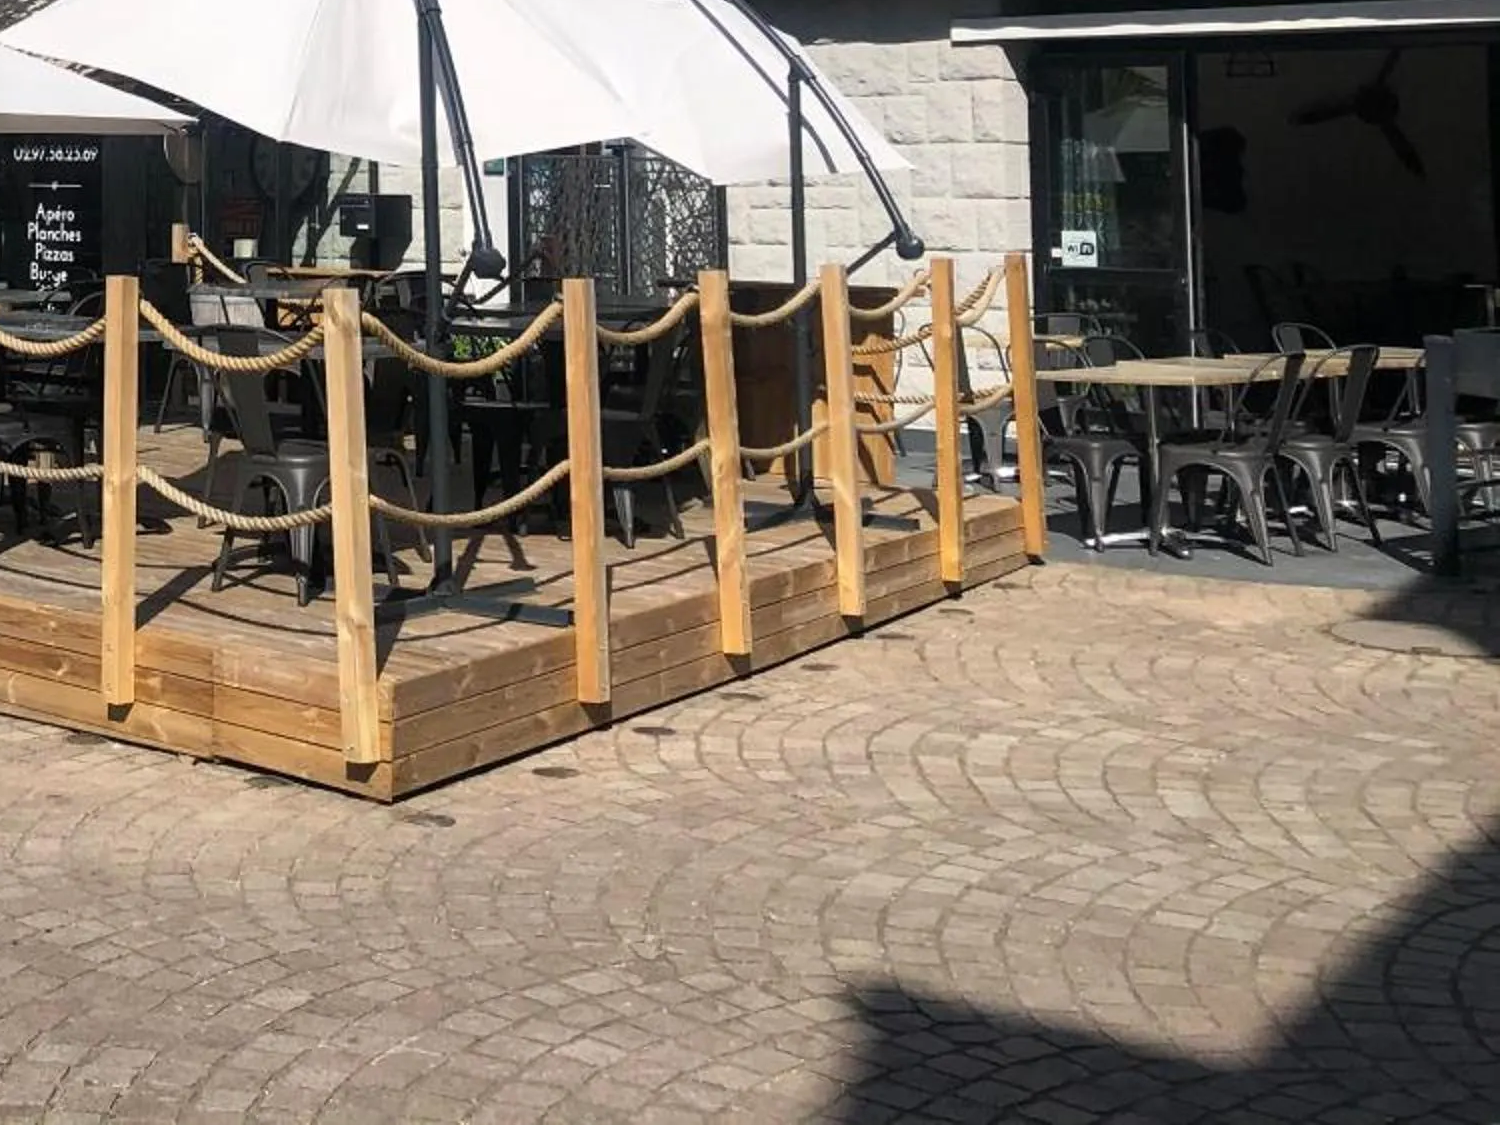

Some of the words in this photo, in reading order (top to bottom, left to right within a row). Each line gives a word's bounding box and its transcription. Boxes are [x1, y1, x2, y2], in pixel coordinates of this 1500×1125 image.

[36, 203, 75, 224] Apéro
[27, 223, 81, 242] Planches
[35, 243, 74, 262] Pizzas
